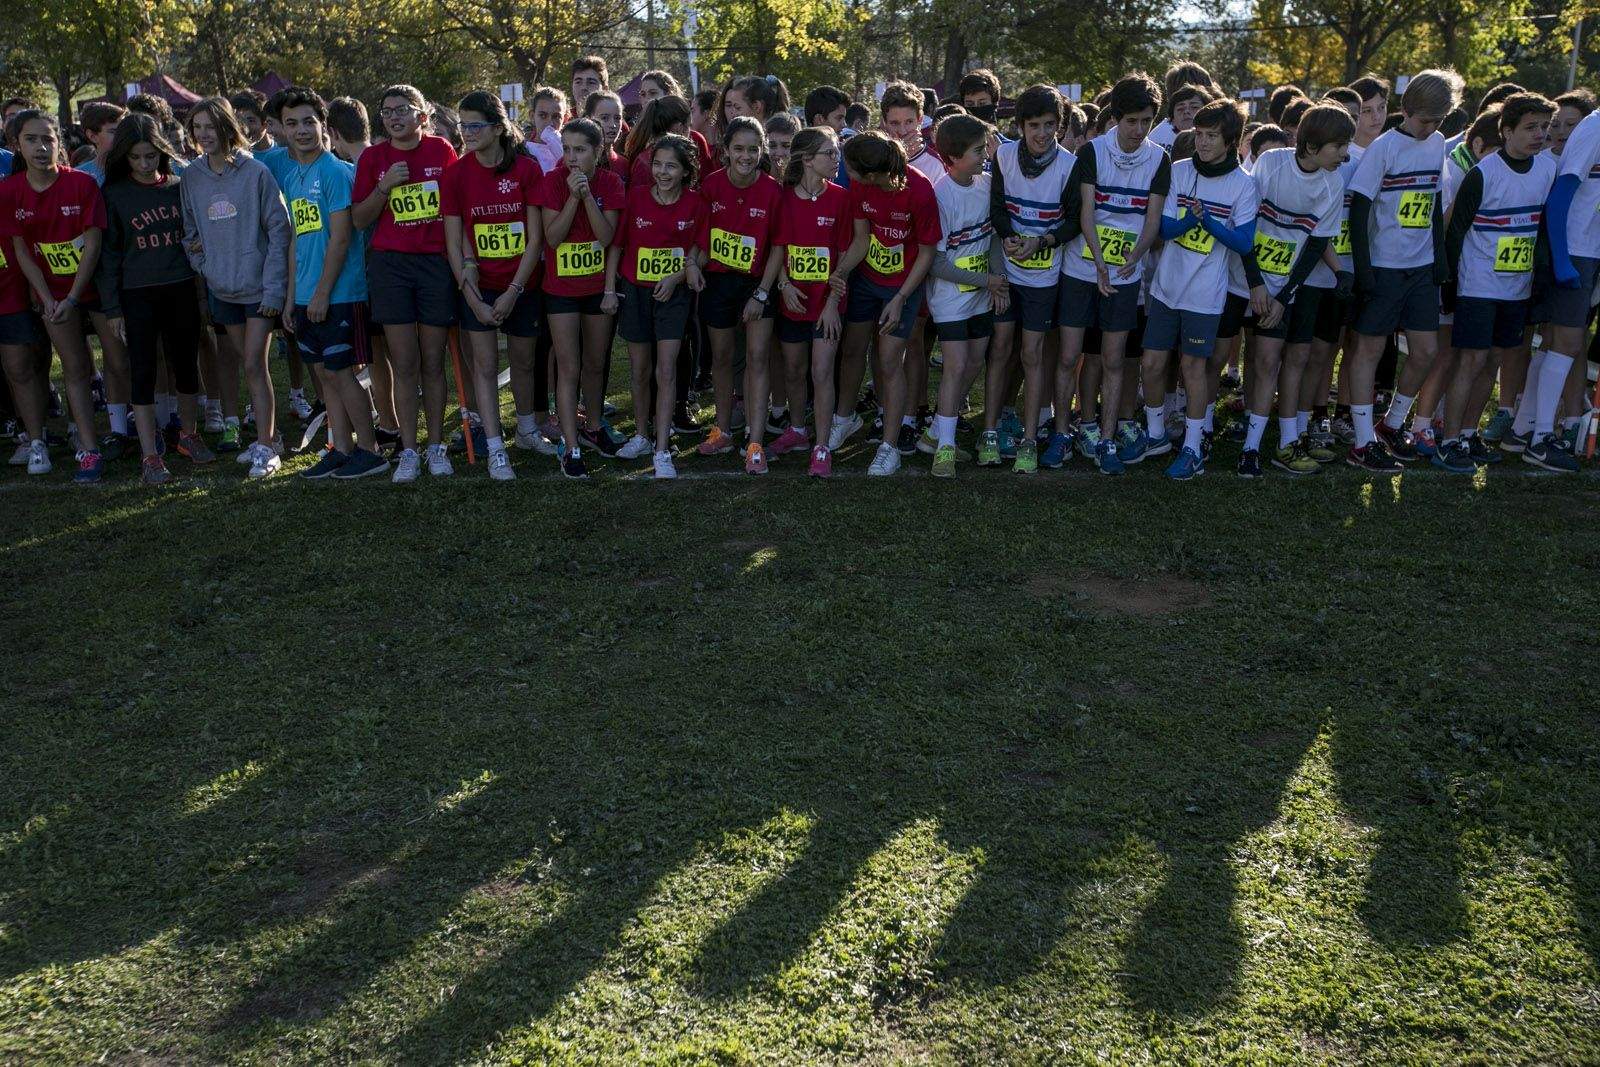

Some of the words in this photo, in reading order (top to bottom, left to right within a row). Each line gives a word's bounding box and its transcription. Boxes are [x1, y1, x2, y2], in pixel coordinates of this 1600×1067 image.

[391, 191, 438, 213] 0614
[470, 203, 522, 217] ATLETISME
[477, 233, 522, 251] 0617
[713, 238, 751, 263] 0618
[46, 245, 85, 268] 061
[559, 250, 603, 269] 1008
[639, 257, 681, 275] 0628
